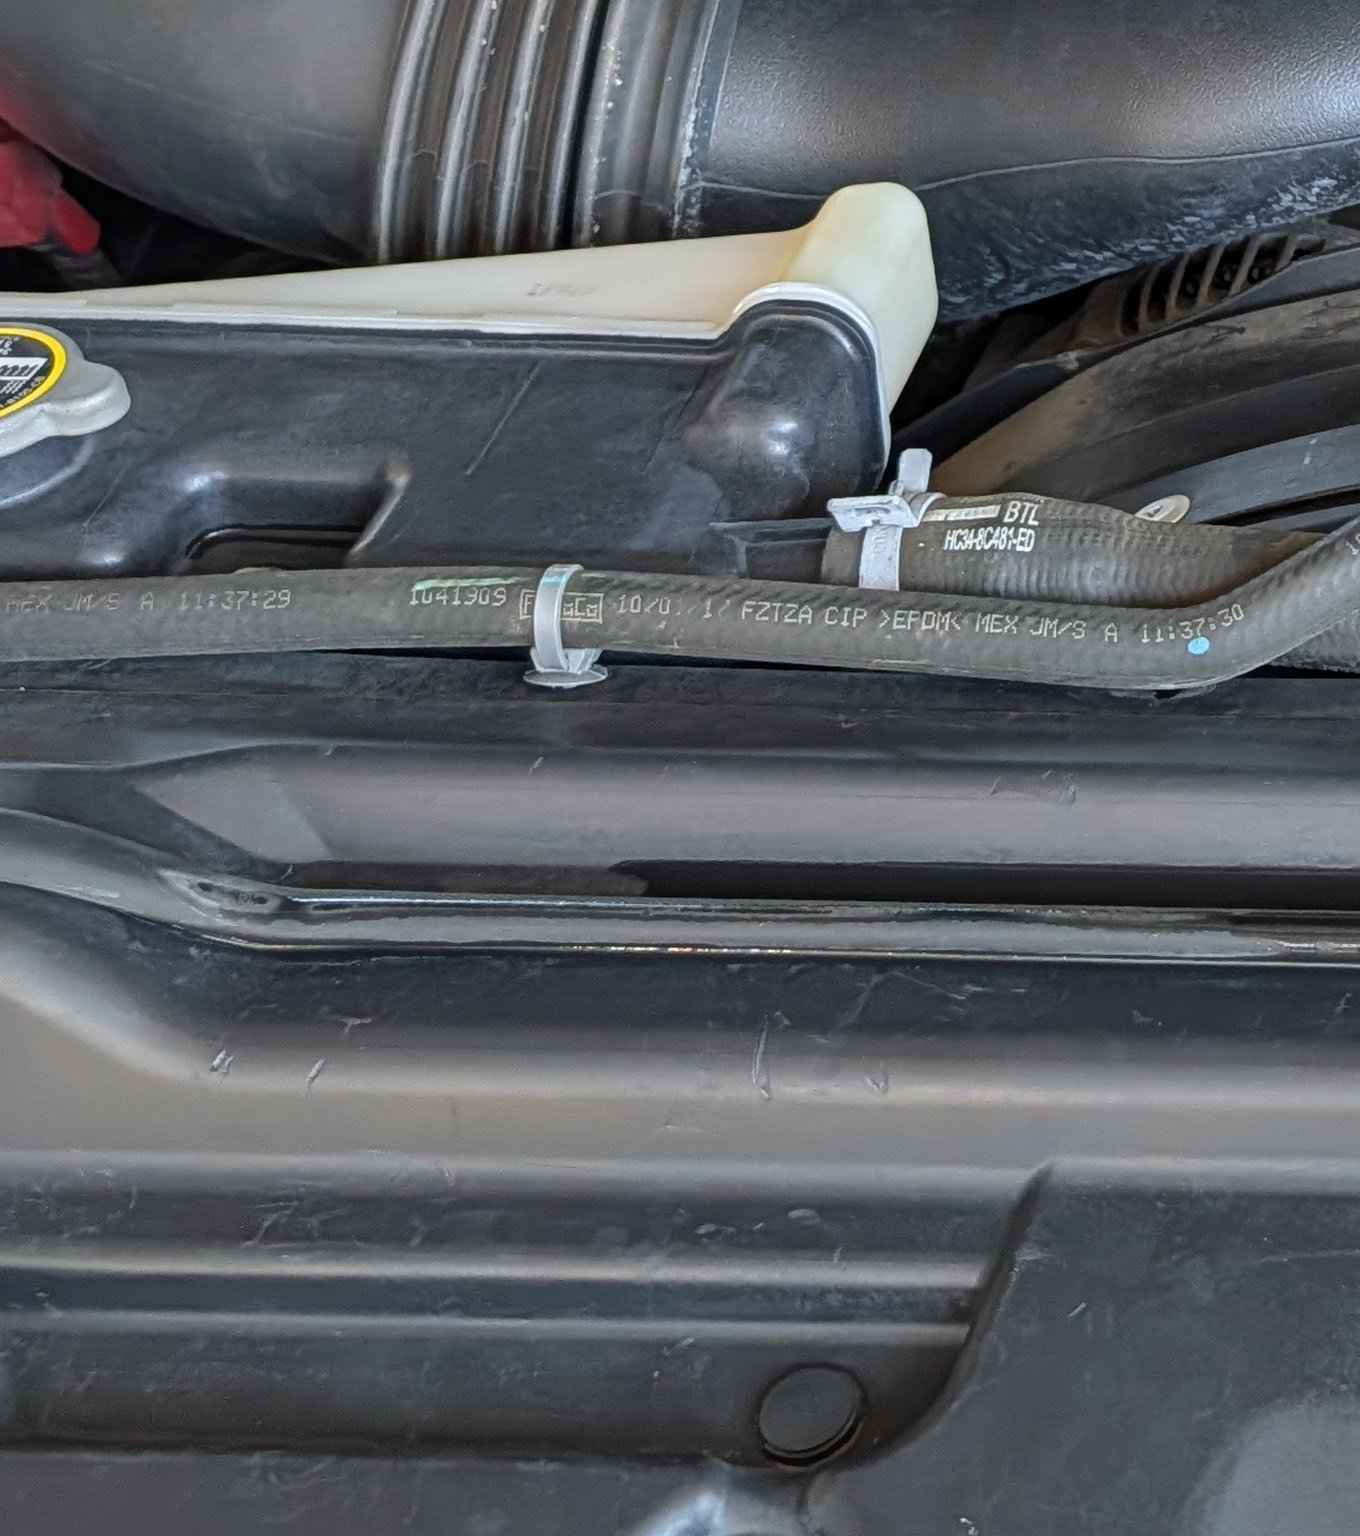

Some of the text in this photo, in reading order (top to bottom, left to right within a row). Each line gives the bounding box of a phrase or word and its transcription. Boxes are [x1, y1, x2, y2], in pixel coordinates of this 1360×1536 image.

[1003, 500, 1040, 526] BTL
[179, 589, 292, 612] 11:37:29
[740, 600, 813, 626] FZTZA
[823, 606, 867, 628] CIP
[975, 612, 1019, 635] MEX
[1104, 622, 1118, 643] A
[1139, 603, 1244, 644] 11:37:30
